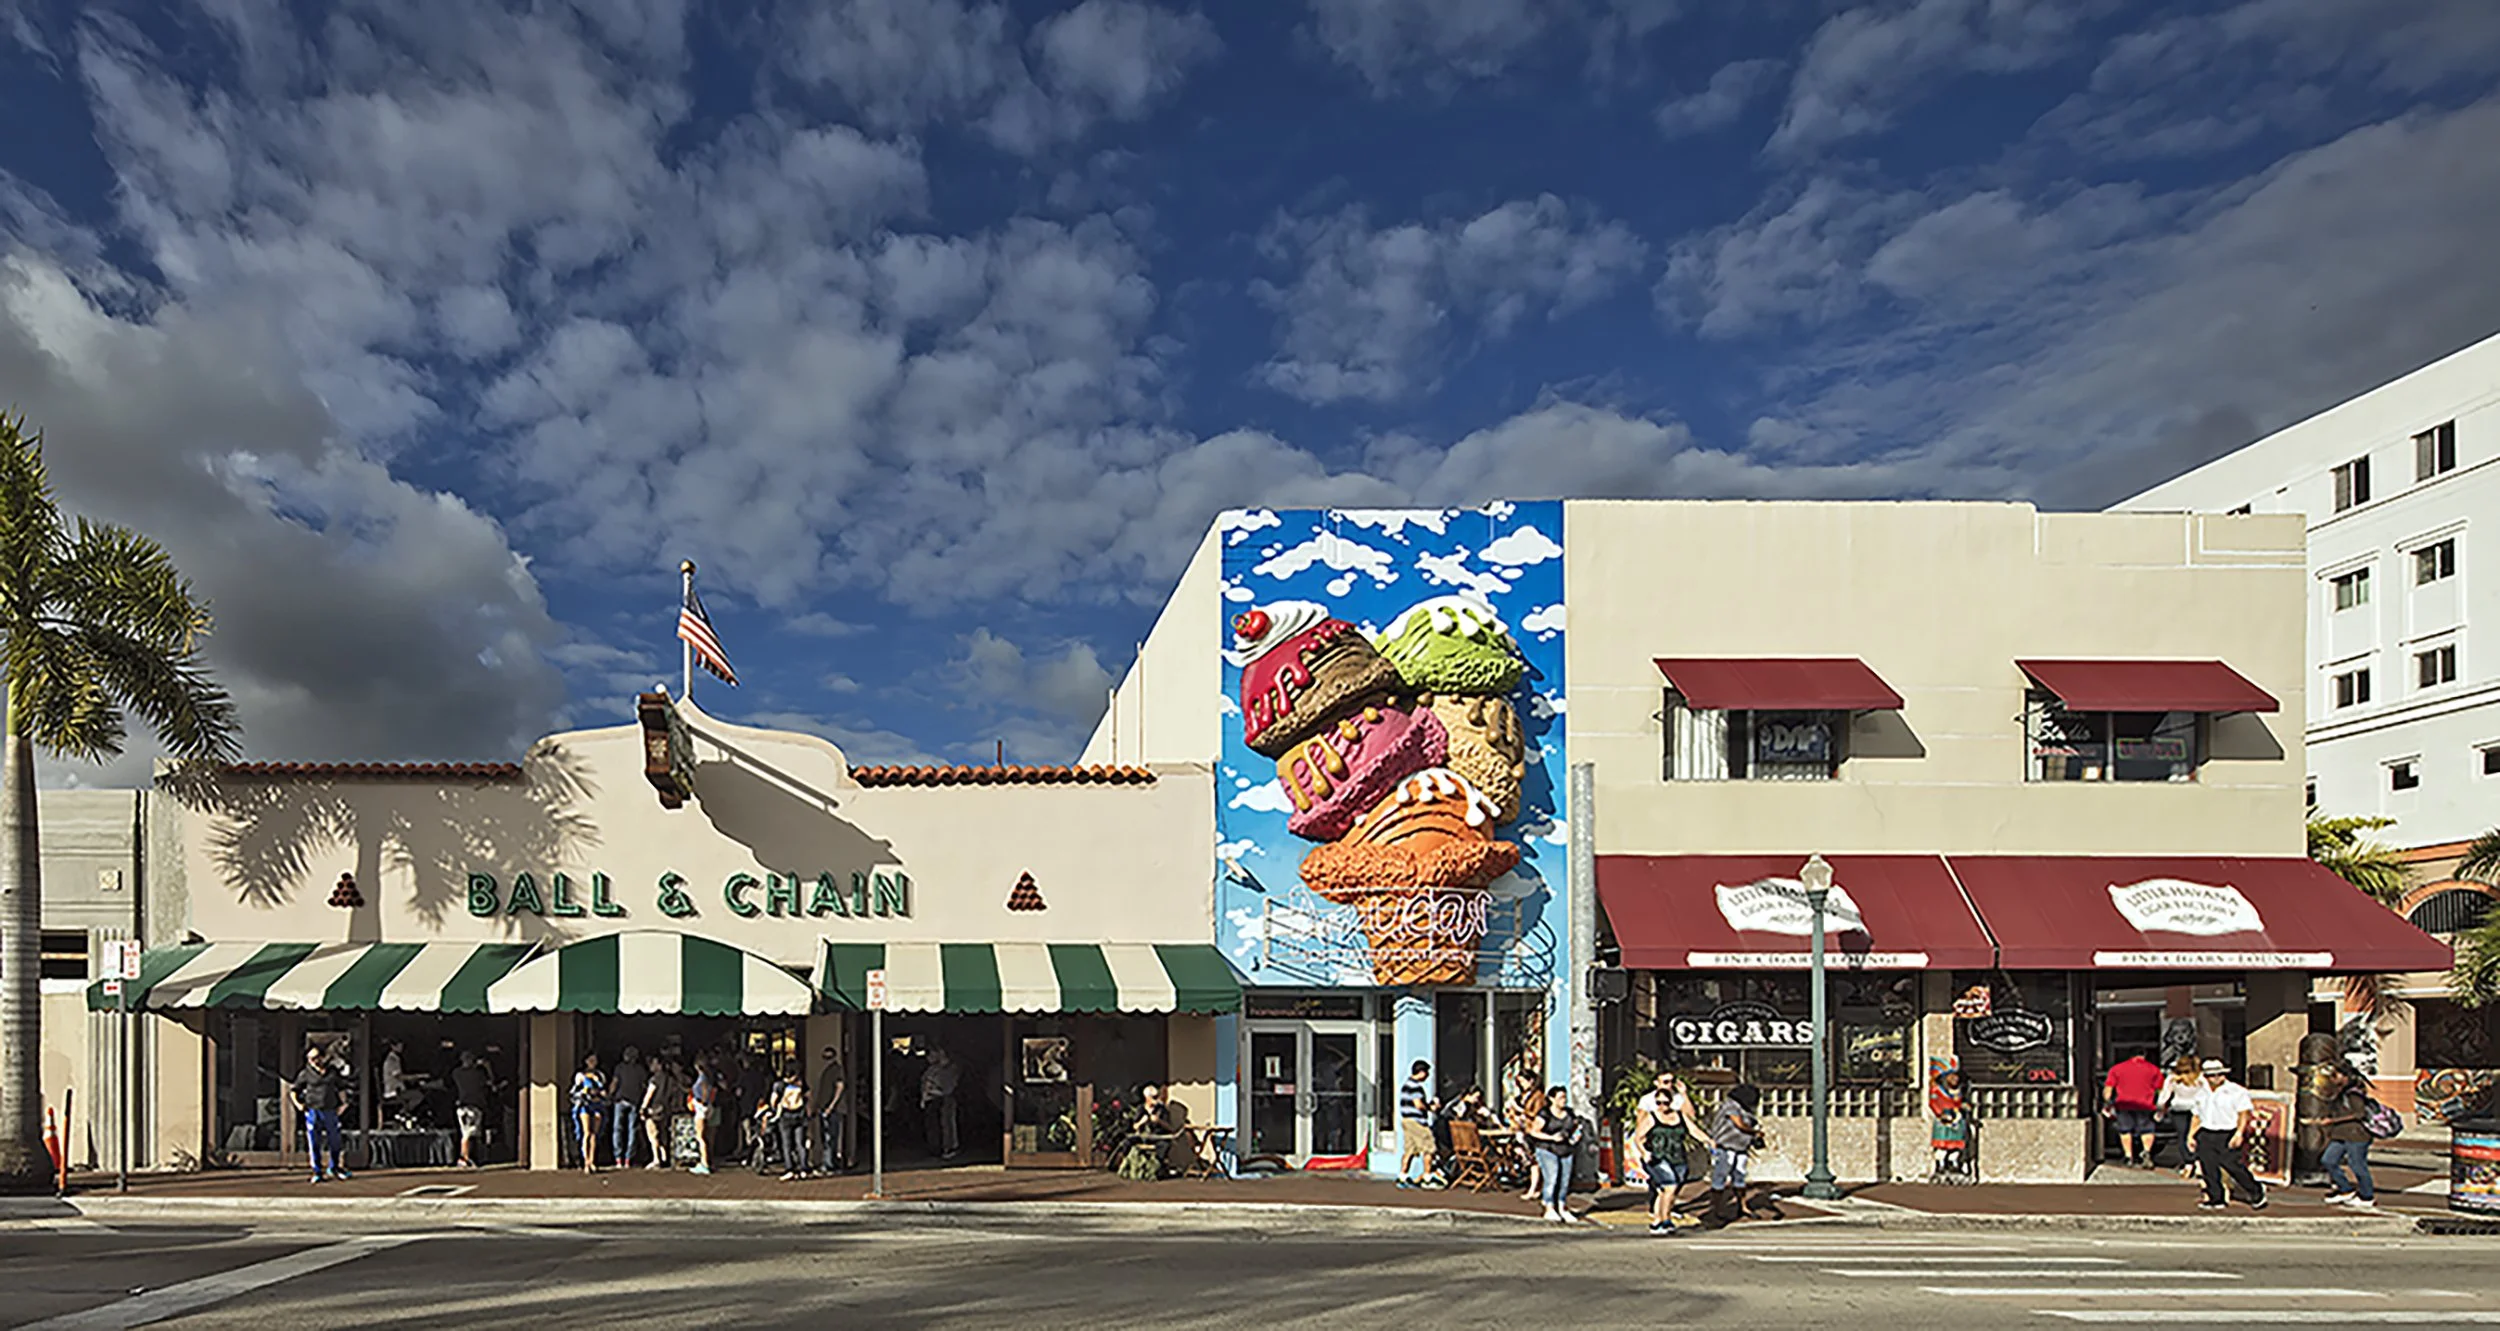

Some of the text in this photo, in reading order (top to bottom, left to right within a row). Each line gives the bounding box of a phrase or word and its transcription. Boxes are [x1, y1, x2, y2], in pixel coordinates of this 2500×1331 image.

[467, 872, 911, 917] BALL & CHAIN
[2126, 886, 2239, 907] LITTLE HAVANA
[2139, 900, 2236, 917] CIGAR FACTORY
[2122, 954, 2158, 963] FINE
[2163, 954, 2224, 963] CIGARS
[1675, 1020, 1814, 1044] CIGARS
[2028, 1069, 2057, 1081] OPEN
